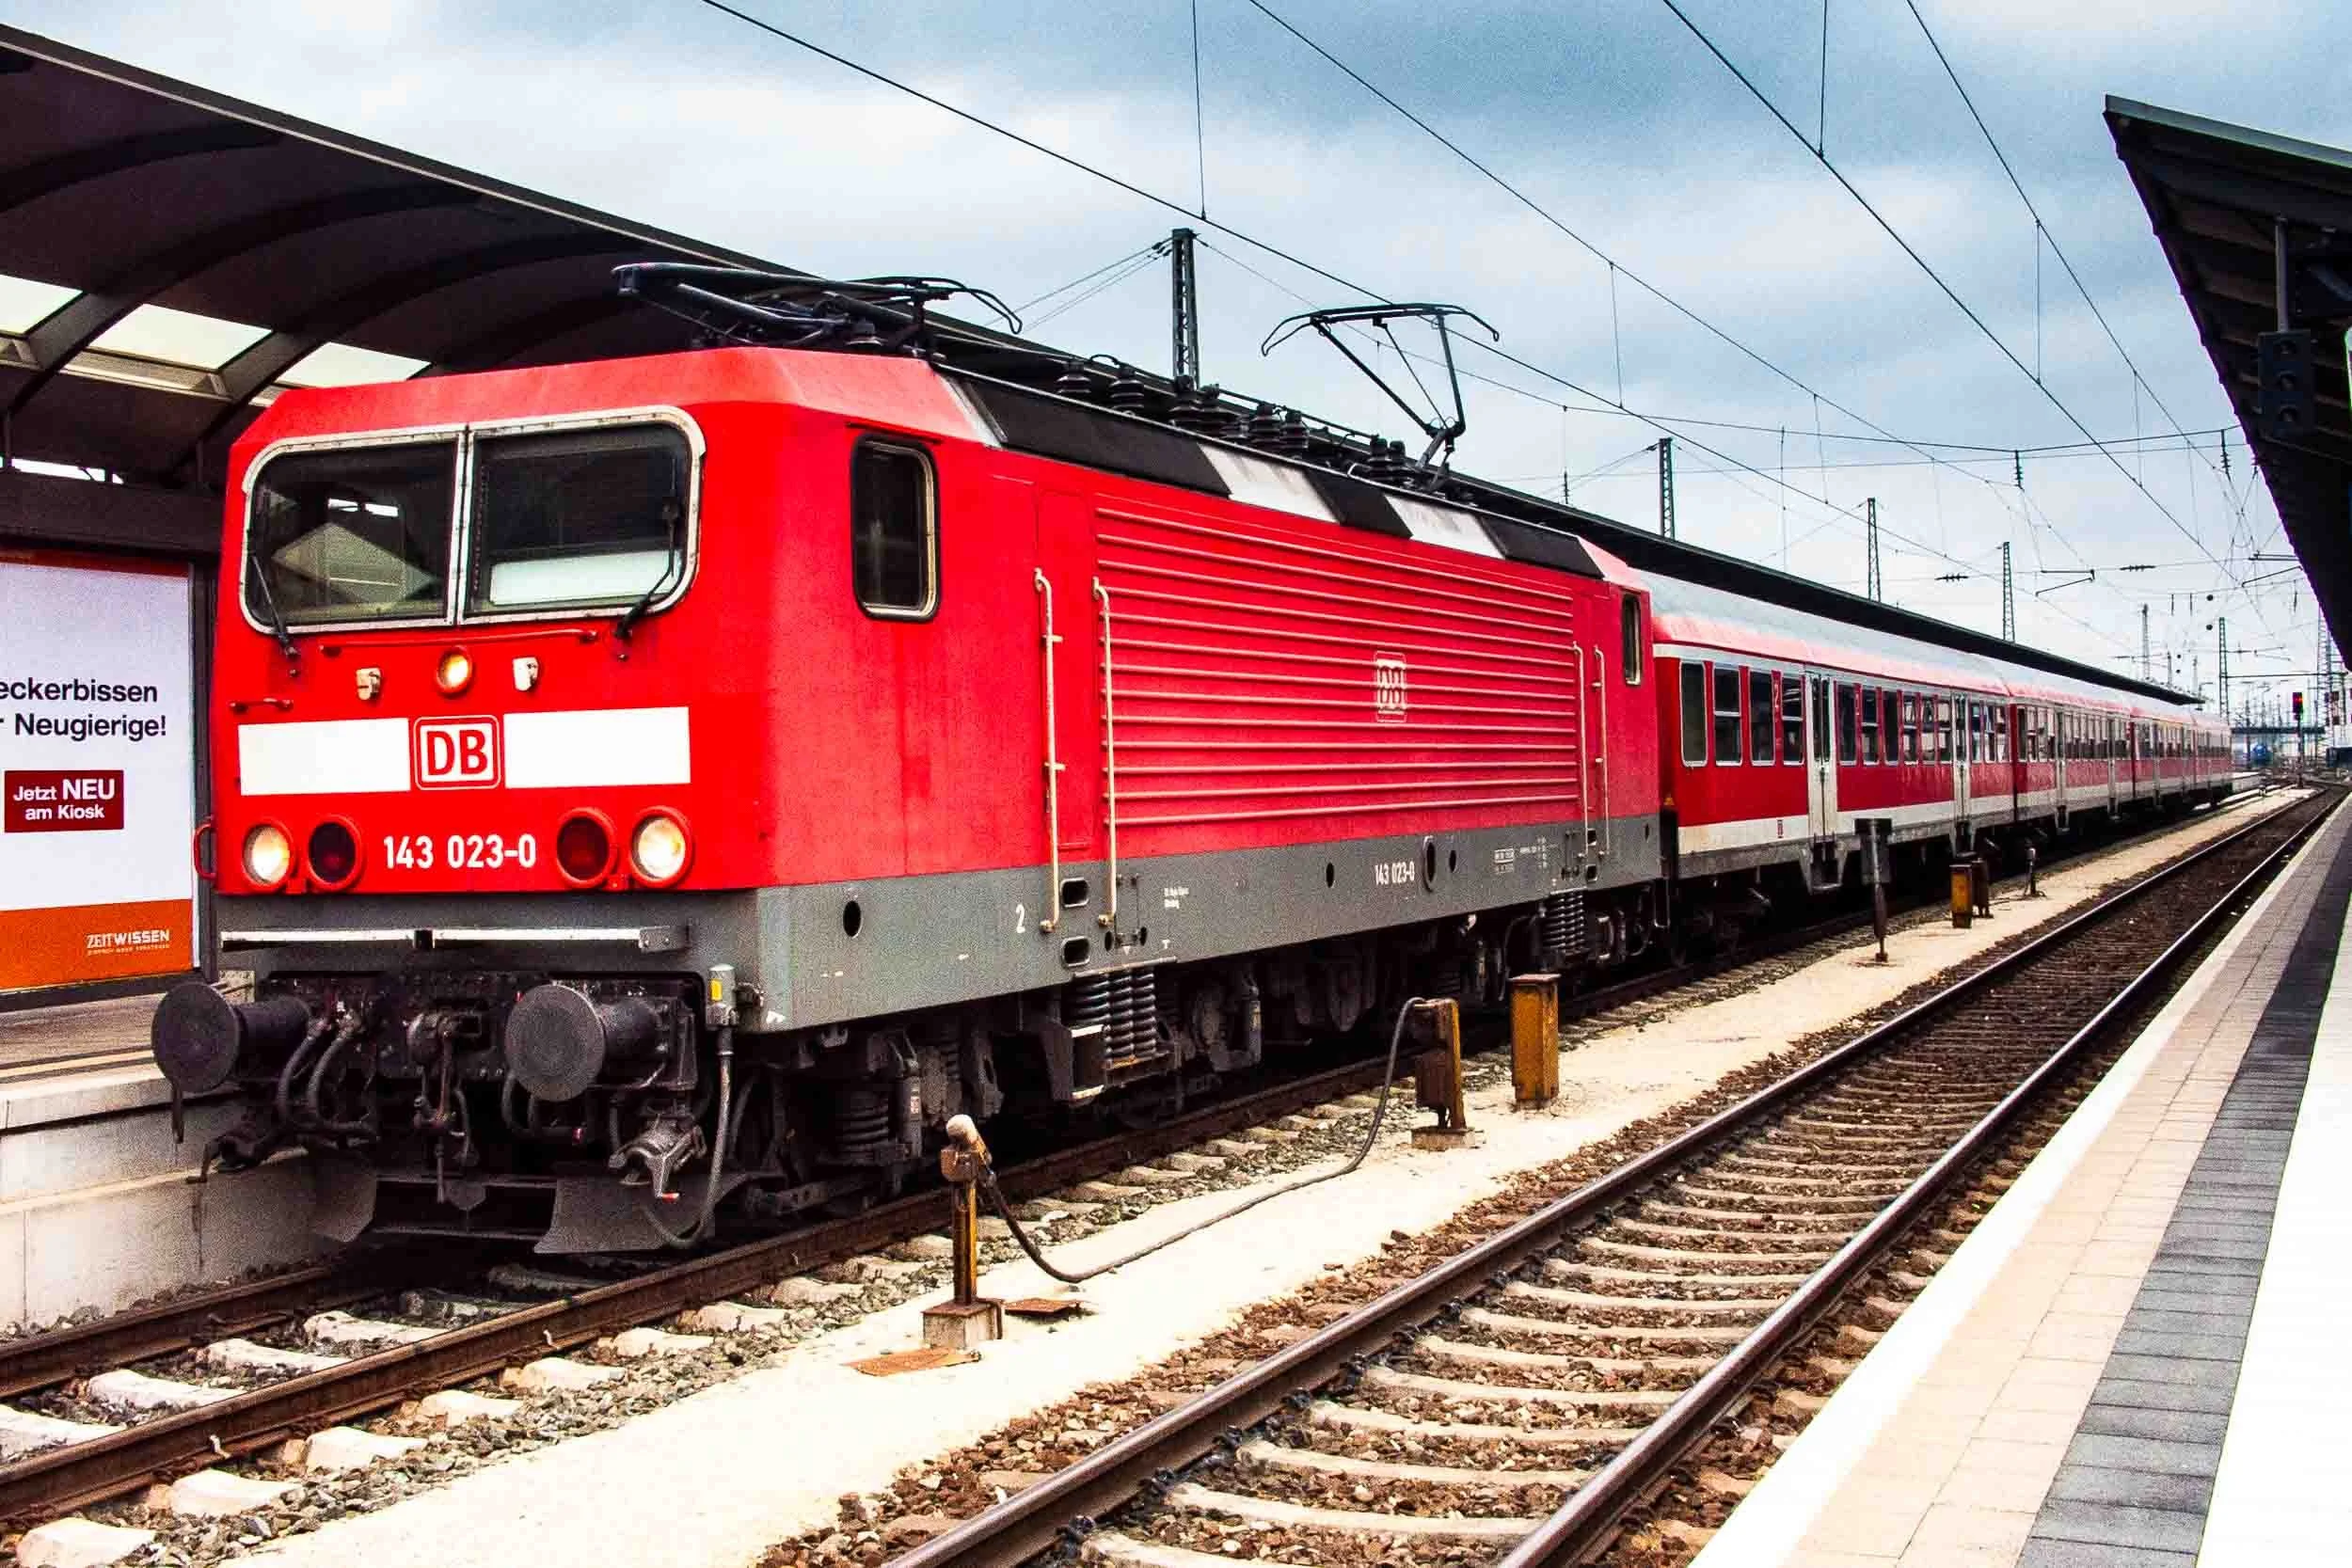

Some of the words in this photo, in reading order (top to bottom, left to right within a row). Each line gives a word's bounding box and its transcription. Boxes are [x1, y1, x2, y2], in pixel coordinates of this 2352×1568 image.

[15, 713, 167, 741] Neugierige!
[426, 729, 488, 776] DB
[13, 785, 57, 801] Jetzt
[62, 778, 116, 800] NEU
[25, 807, 53, 820] am
[57, 803, 105, 819] Kiosk
[383, 835, 434, 869] 143
[447, 833, 536, 869] 023-0
[1375, 863, 1390, 885] 143
[1391, 861, 1415, 883] 023-0
[1015, 904, 1026, 934] 2
